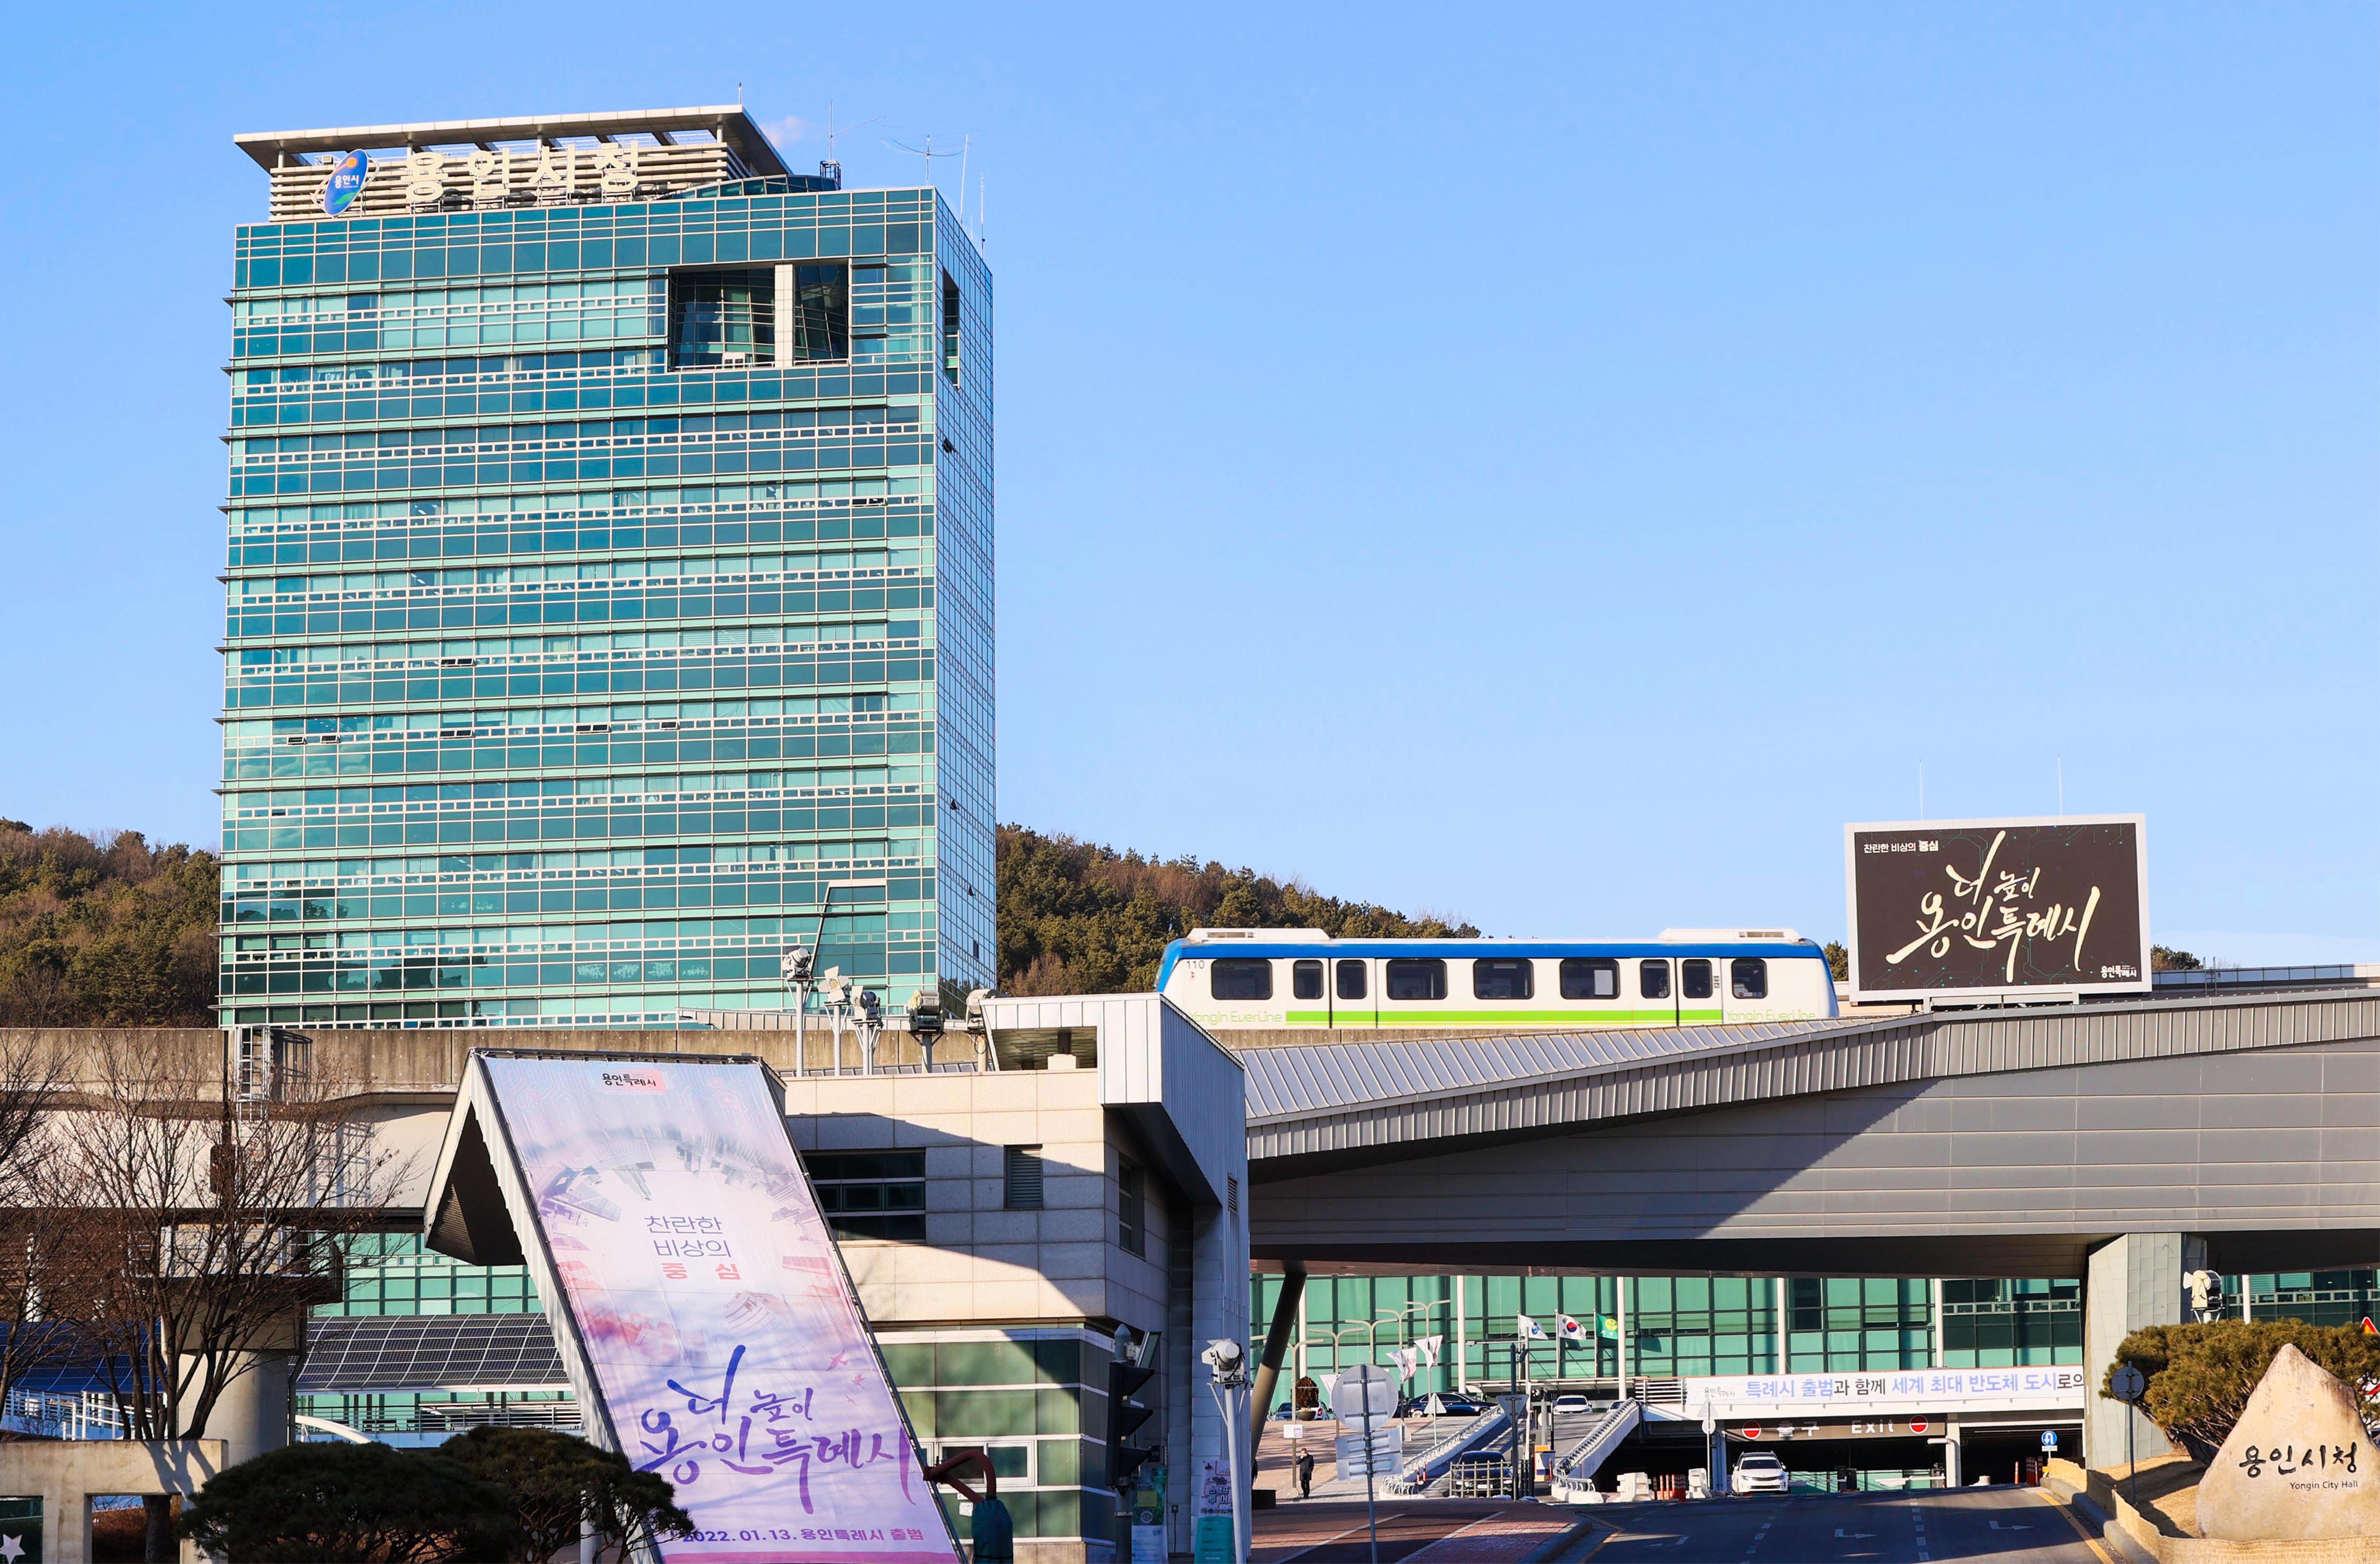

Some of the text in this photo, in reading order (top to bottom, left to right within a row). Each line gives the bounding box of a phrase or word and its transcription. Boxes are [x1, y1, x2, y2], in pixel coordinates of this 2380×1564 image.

[400, 141, 638, 202] 용인시청
[334, 175, 359, 189] 용인시
[1863, 840, 1939, 853] 찬란한 비상의 중심
[1994, 866, 2041, 902] 높이
[1885, 885, 2101, 983] 용인특례시
[1186, 960, 1205, 969] 110
[2100, 965, 2137, 979] 용인특례시
[602, 1073, 656, 1087] 용인특례시
[644, 1216, 723, 1234] 찬란한
[653, 1239, 732, 1257] 비상의
[1704, 1387, 1735, 1398] 용인특례시
[1746, 1380, 1795, 1398] 특례시
[1801, 1378, 1850, 1398] 출범과
[1855, 1378, 1886, 1395] 함께
[1891, 1376, 1924, 1394] 세계
[1931, 1375, 1962, 1393] 최대
[1969, 1374, 2018, 1392] 반도체
[750, 1388, 813, 1422] 높이
[1851, 1419, 1894, 1434] Exit
[632, 1408, 915, 1514] 용인특례시
[2239, 1442, 2358, 1478] 용인시청
[2290, 1481, 2320, 1491] Yongin
[2322, 1481, 2339, 1490] City
[891, 1528, 924, 1541] 출범
